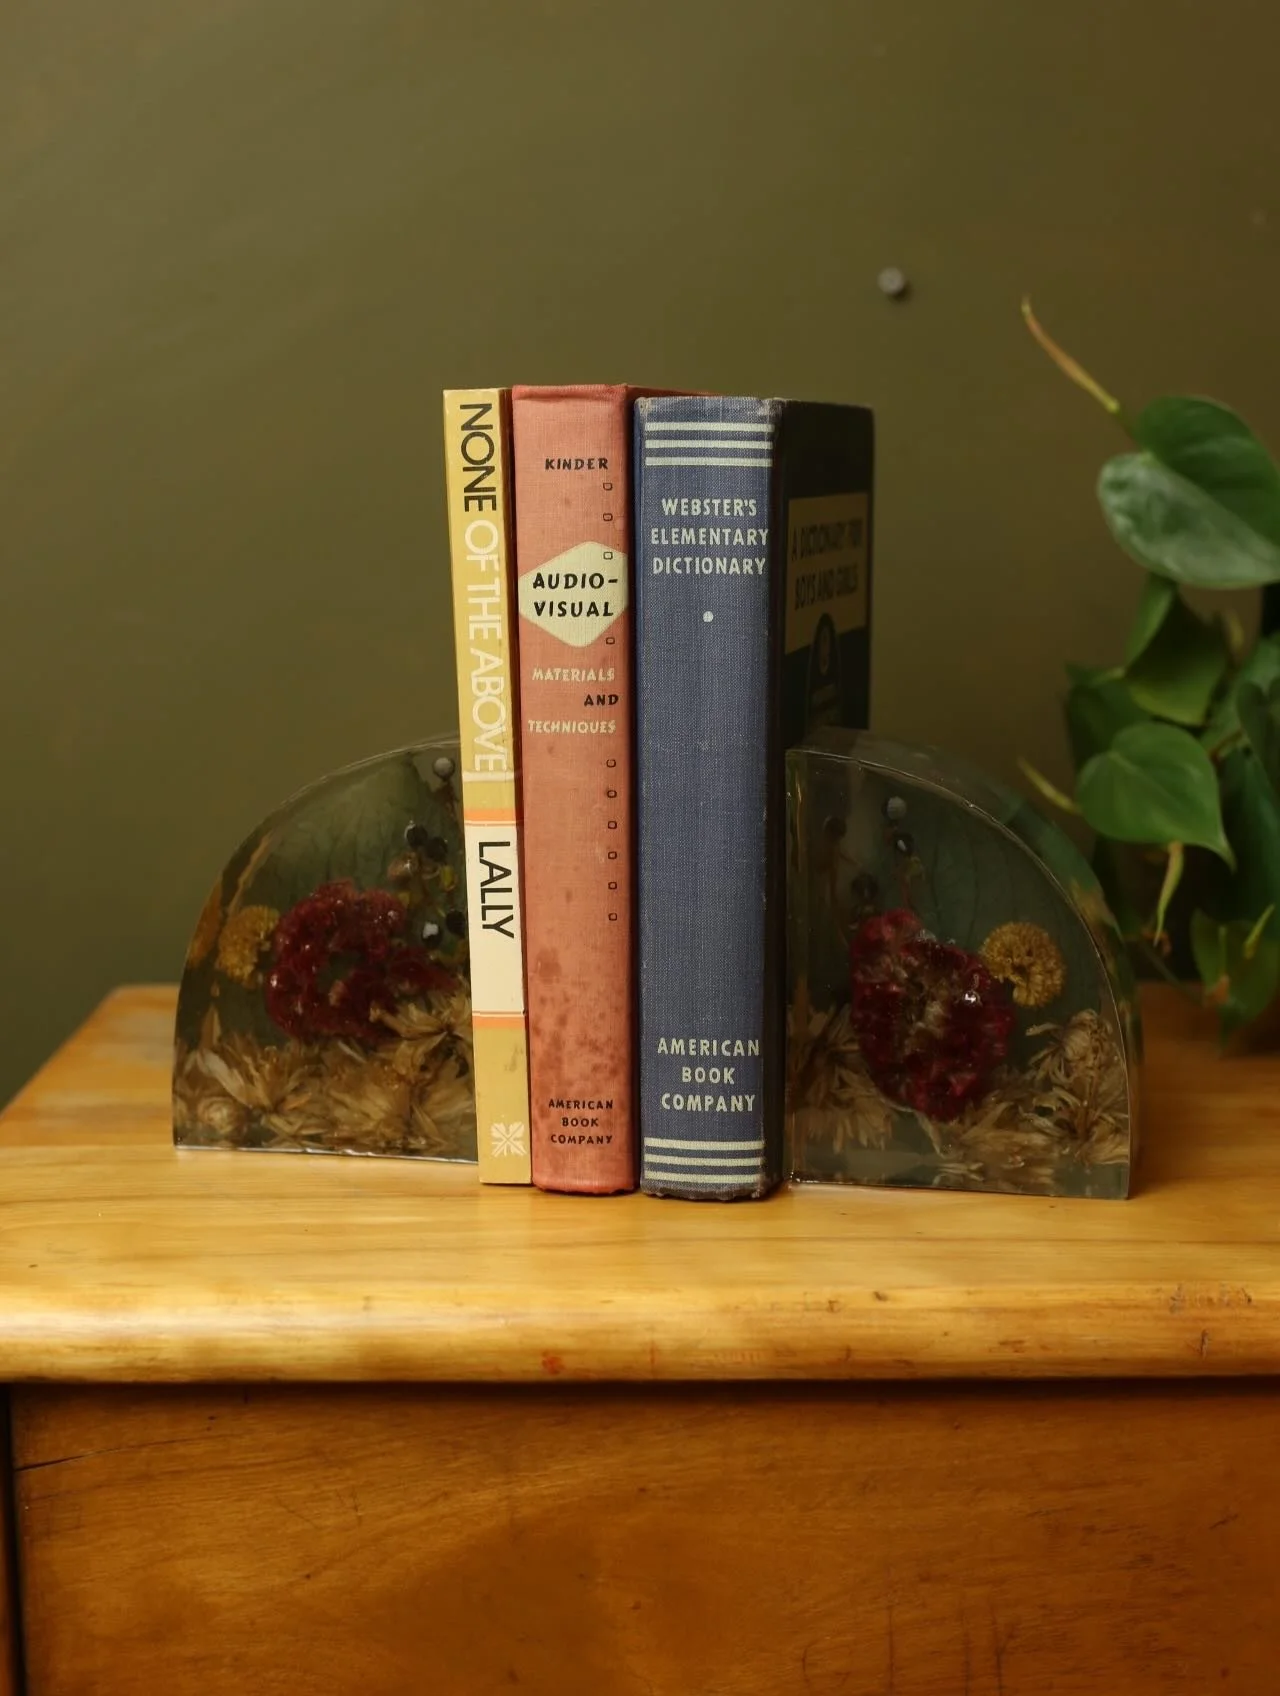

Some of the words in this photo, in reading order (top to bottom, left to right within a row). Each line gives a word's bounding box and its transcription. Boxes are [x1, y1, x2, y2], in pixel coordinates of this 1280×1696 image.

[460, 403, 497, 512] NONE
[545, 458, 609, 470] KINDER
[661, 498, 757, 516] WEBSTER'S
[464, 519, 499, 571] OF
[651, 527, 769, 545] ELEMENTARY
[791, 527, 799, 561] A
[652, 557, 766, 575] DICTIONARY
[532, 572, 619, 590] AUDIO-
[467, 577, 502, 640] THE
[534, 601, 613, 618] VISUAL
[532, 667, 615, 682] MATERIALS
[583, 694, 619, 706] AND
[470, 648, 508, 772] ABOVE
[528, 720, 616, 734] TECHNIQUES
[478, 841, 514, 939] LALLY
[657, 1038, 760, 1057] AMERICAN
[681, 1067, 735, 1084] BOOK
[548, 1099, 613, 1110] AMERICAN
[661, 1093, 755, 1112] COMPANY
[562, 1117, 599, 1127] BOOK
[551, 1133, 613, 1144] COMPANY
